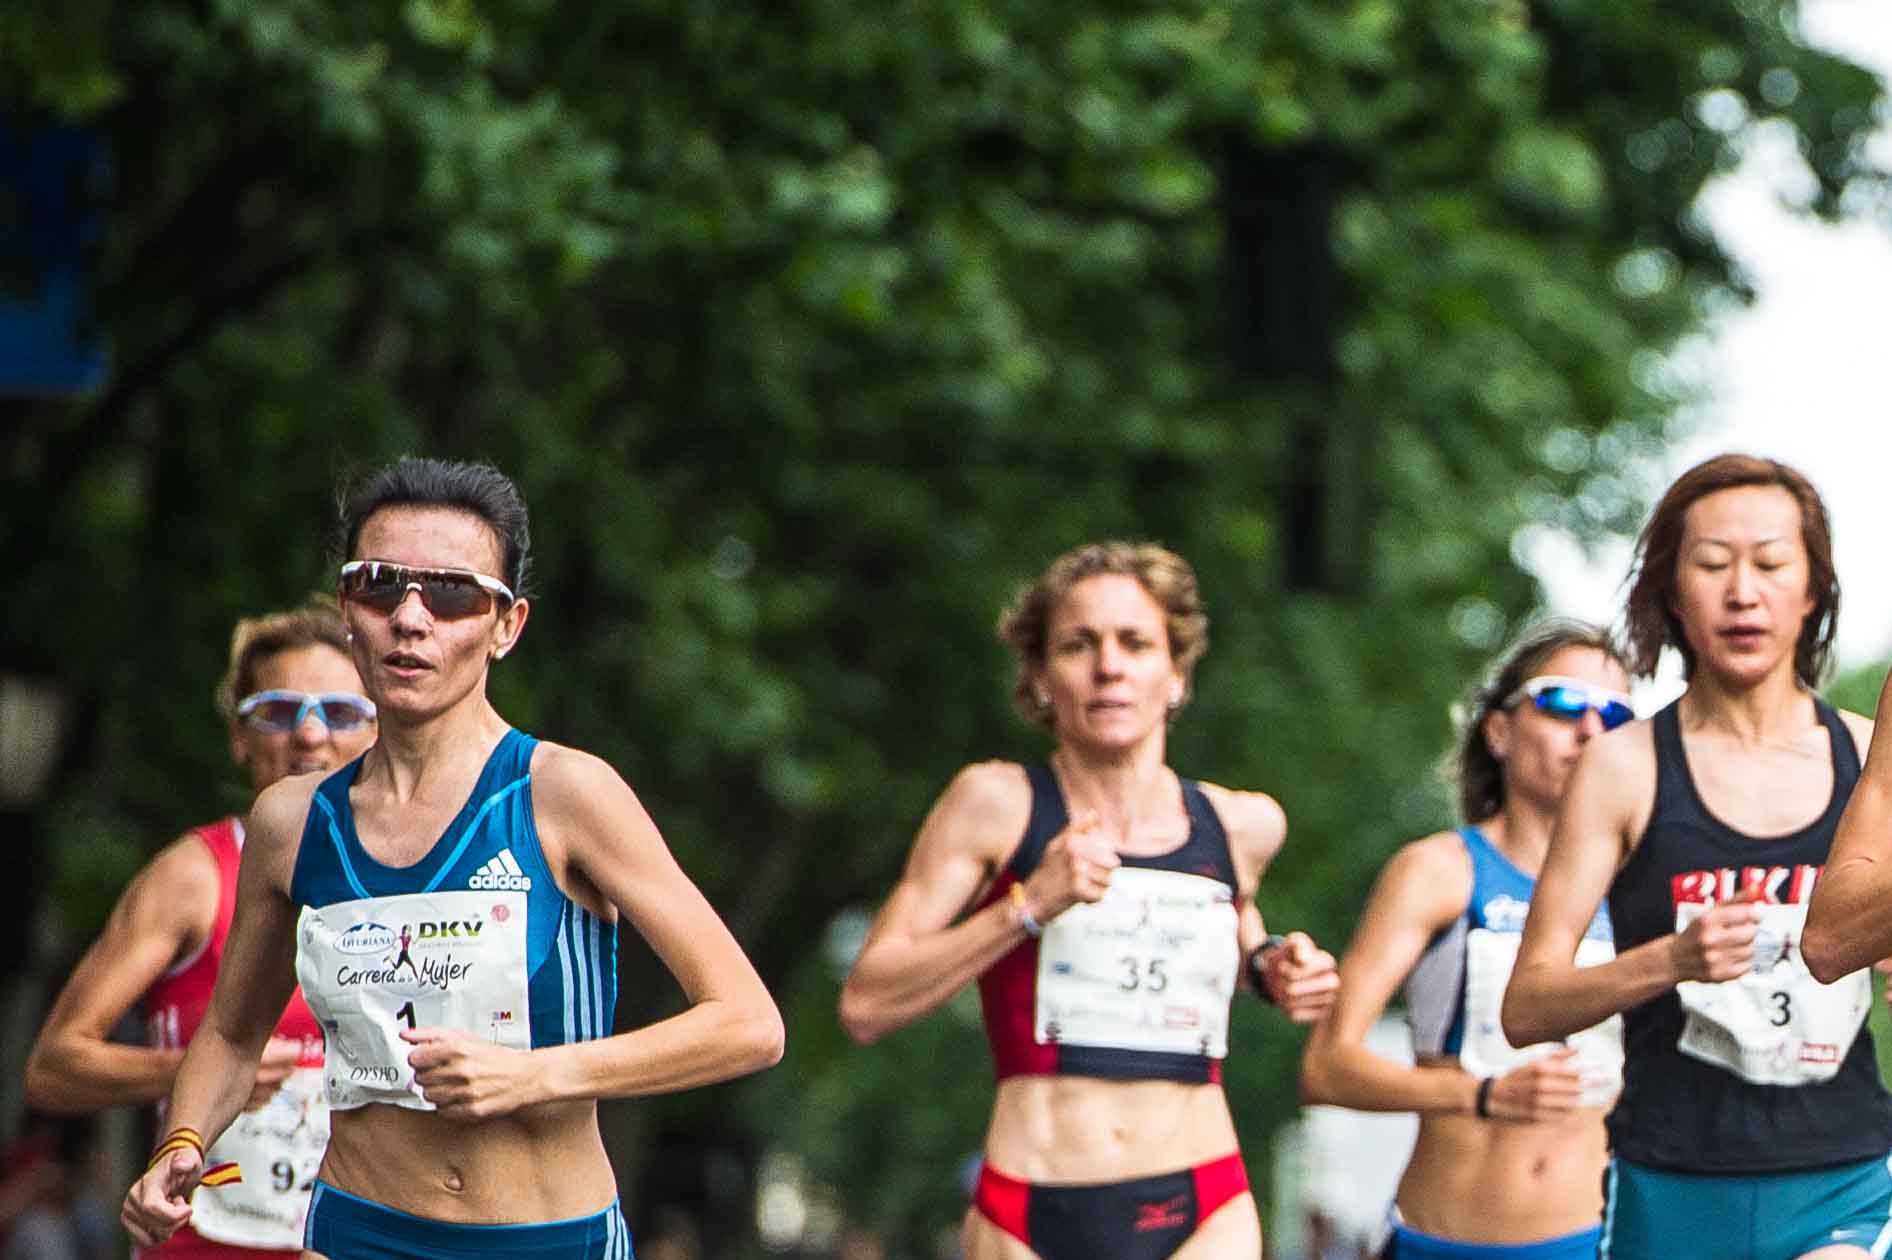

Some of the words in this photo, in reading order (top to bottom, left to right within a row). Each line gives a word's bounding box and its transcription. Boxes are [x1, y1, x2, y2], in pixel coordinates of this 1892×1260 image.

[469, 874, 532, 890] adidas
[419, 921, 483, 938] DKV
[337, 965, 396, 986] Carrera
[420, 954, 473, 990] Mujer
[1119, 956, 1167, 992] 35
[1770, 992, 1791, 1026] 3
